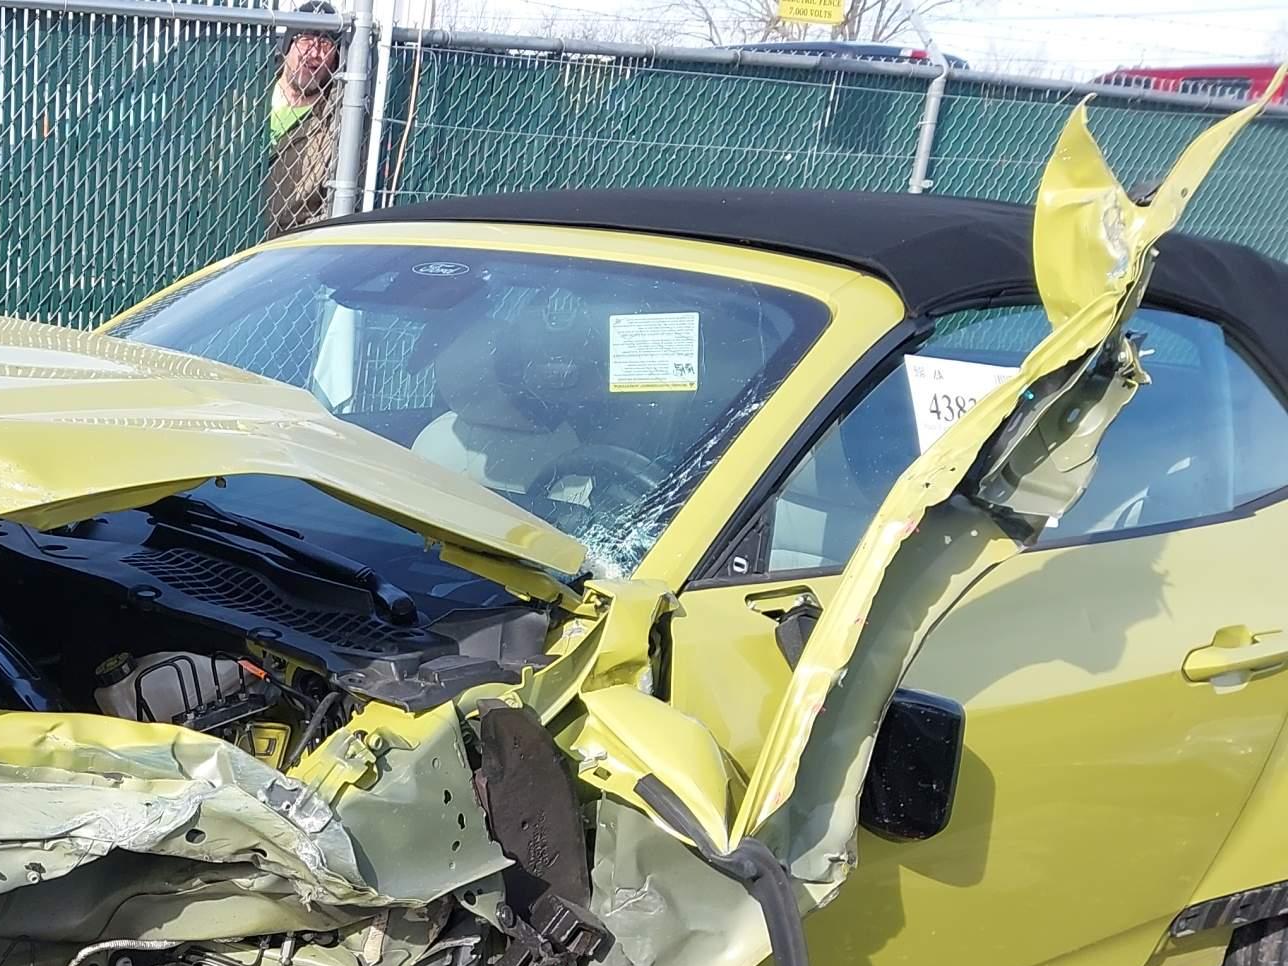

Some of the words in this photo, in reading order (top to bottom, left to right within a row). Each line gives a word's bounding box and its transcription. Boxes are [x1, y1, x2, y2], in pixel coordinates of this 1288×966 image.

[789, 6, 808, 16] 7,000
[810, 9, 832, 18] VOLTS
[419, 263, 461, 274] Ford
